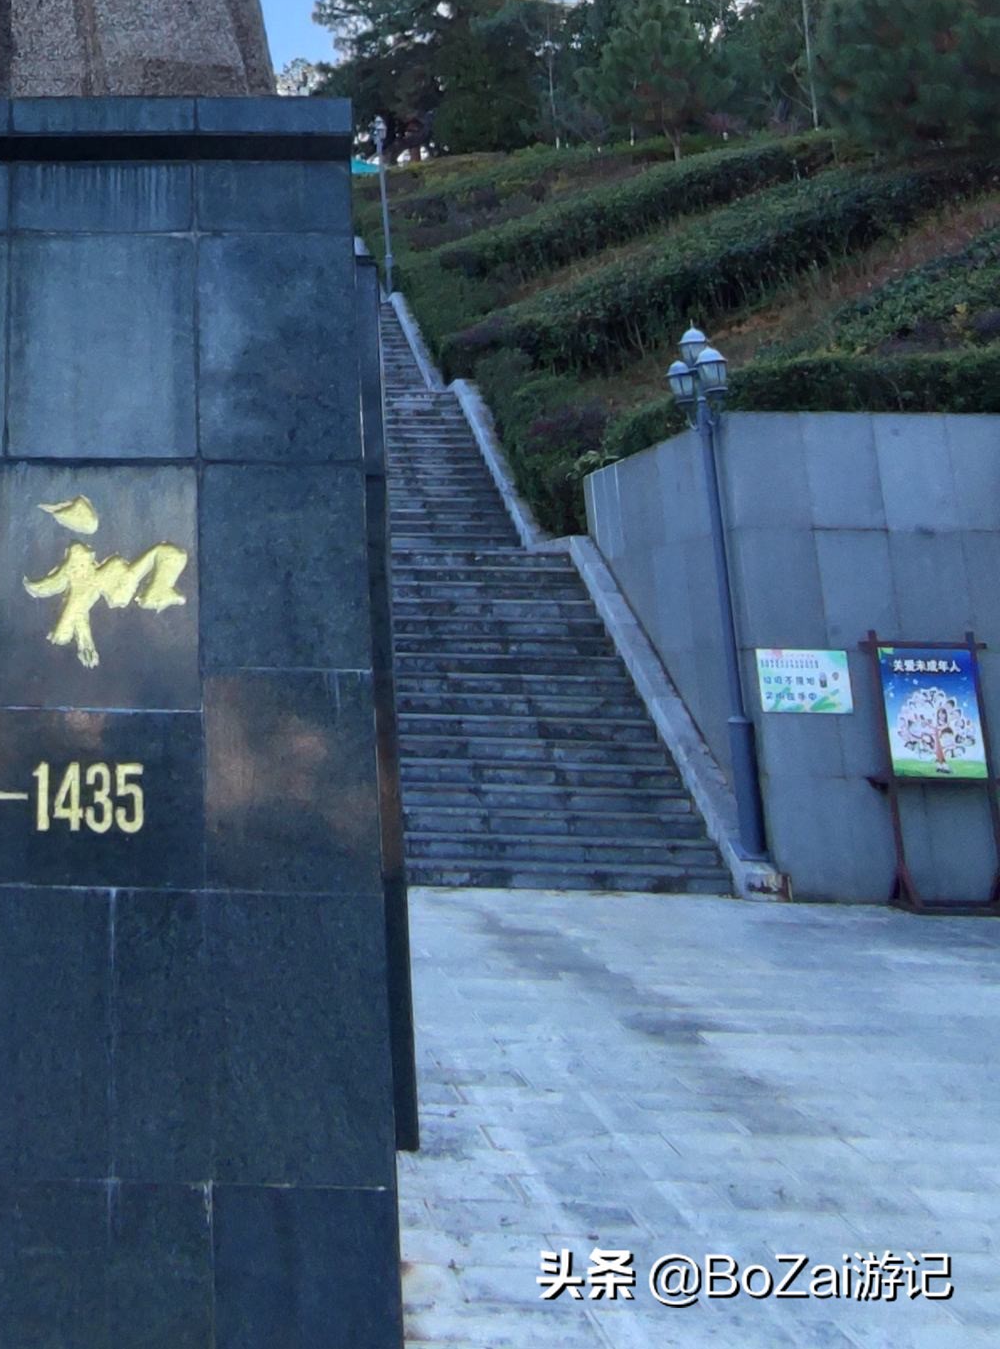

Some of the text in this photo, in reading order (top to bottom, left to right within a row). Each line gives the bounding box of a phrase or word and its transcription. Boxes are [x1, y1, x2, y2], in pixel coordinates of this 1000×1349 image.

[893, 659, 961, 672] 关爱未成年人
